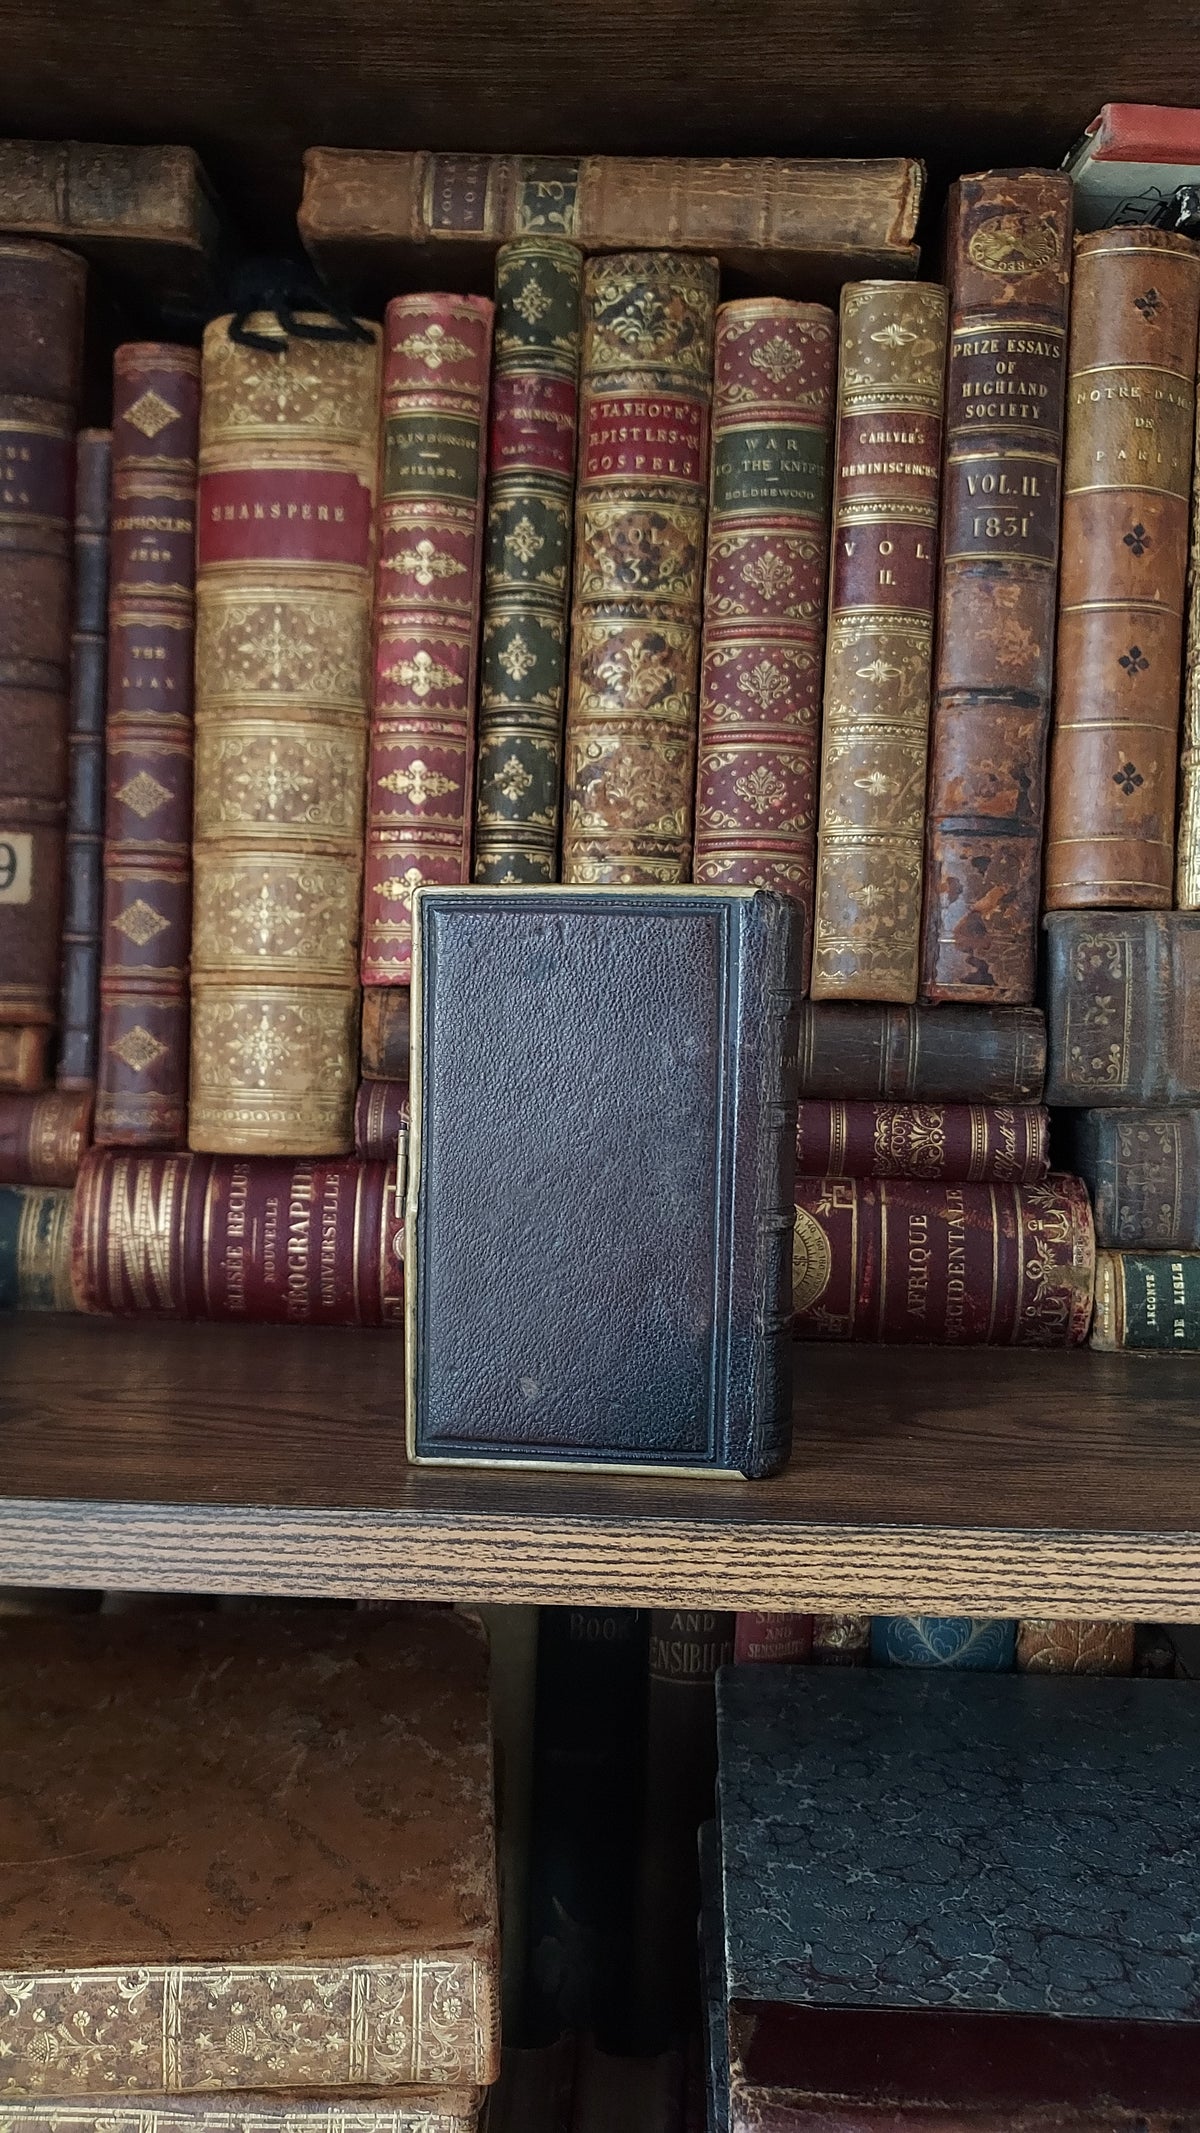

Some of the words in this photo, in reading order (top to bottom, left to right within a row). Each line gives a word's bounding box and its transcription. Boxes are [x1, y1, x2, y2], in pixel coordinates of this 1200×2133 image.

[953, 339, 999, 358] PRIZE
[1006, 339, 1060, 359] ESSAYS
[995, 361, 1016, 375] OF
[962, 381, 1048, 398] HIGHLAND
[590, 402, 698, 424] STANHOPE'S
[965, 403, 1041, 419] SOCIETY
[1135, 417, 1154, 428] DE
[745, 438, 798, 453] WAR
[859, 428, 925, 445] CARLYLE'S
[588, 454, 693, 476] GOSPELS
[741, 459, 772, 472] THE
[1096, 449, 1177, 467] PARIS
[211, 502, 345, 522] SHAKSPERE
[972, 516, 1029, 538] 1831
[878, 569, 897, 586] II.
[227, 1163, 250, 1237] RECLUS
[264, 1196, 278, 1284] NOUVELLE
[321, 1173, 340, 1307] UNIVERSELLE
[907, 1213, 931, 1319] AFRIQUE
[1171, 1262, 1185, 1305] LISLE
[1173, 1318, 1185, 1338] DE
[670, 1612, 716, 1632] AND
[764, 1628, 792, 1640] AND
